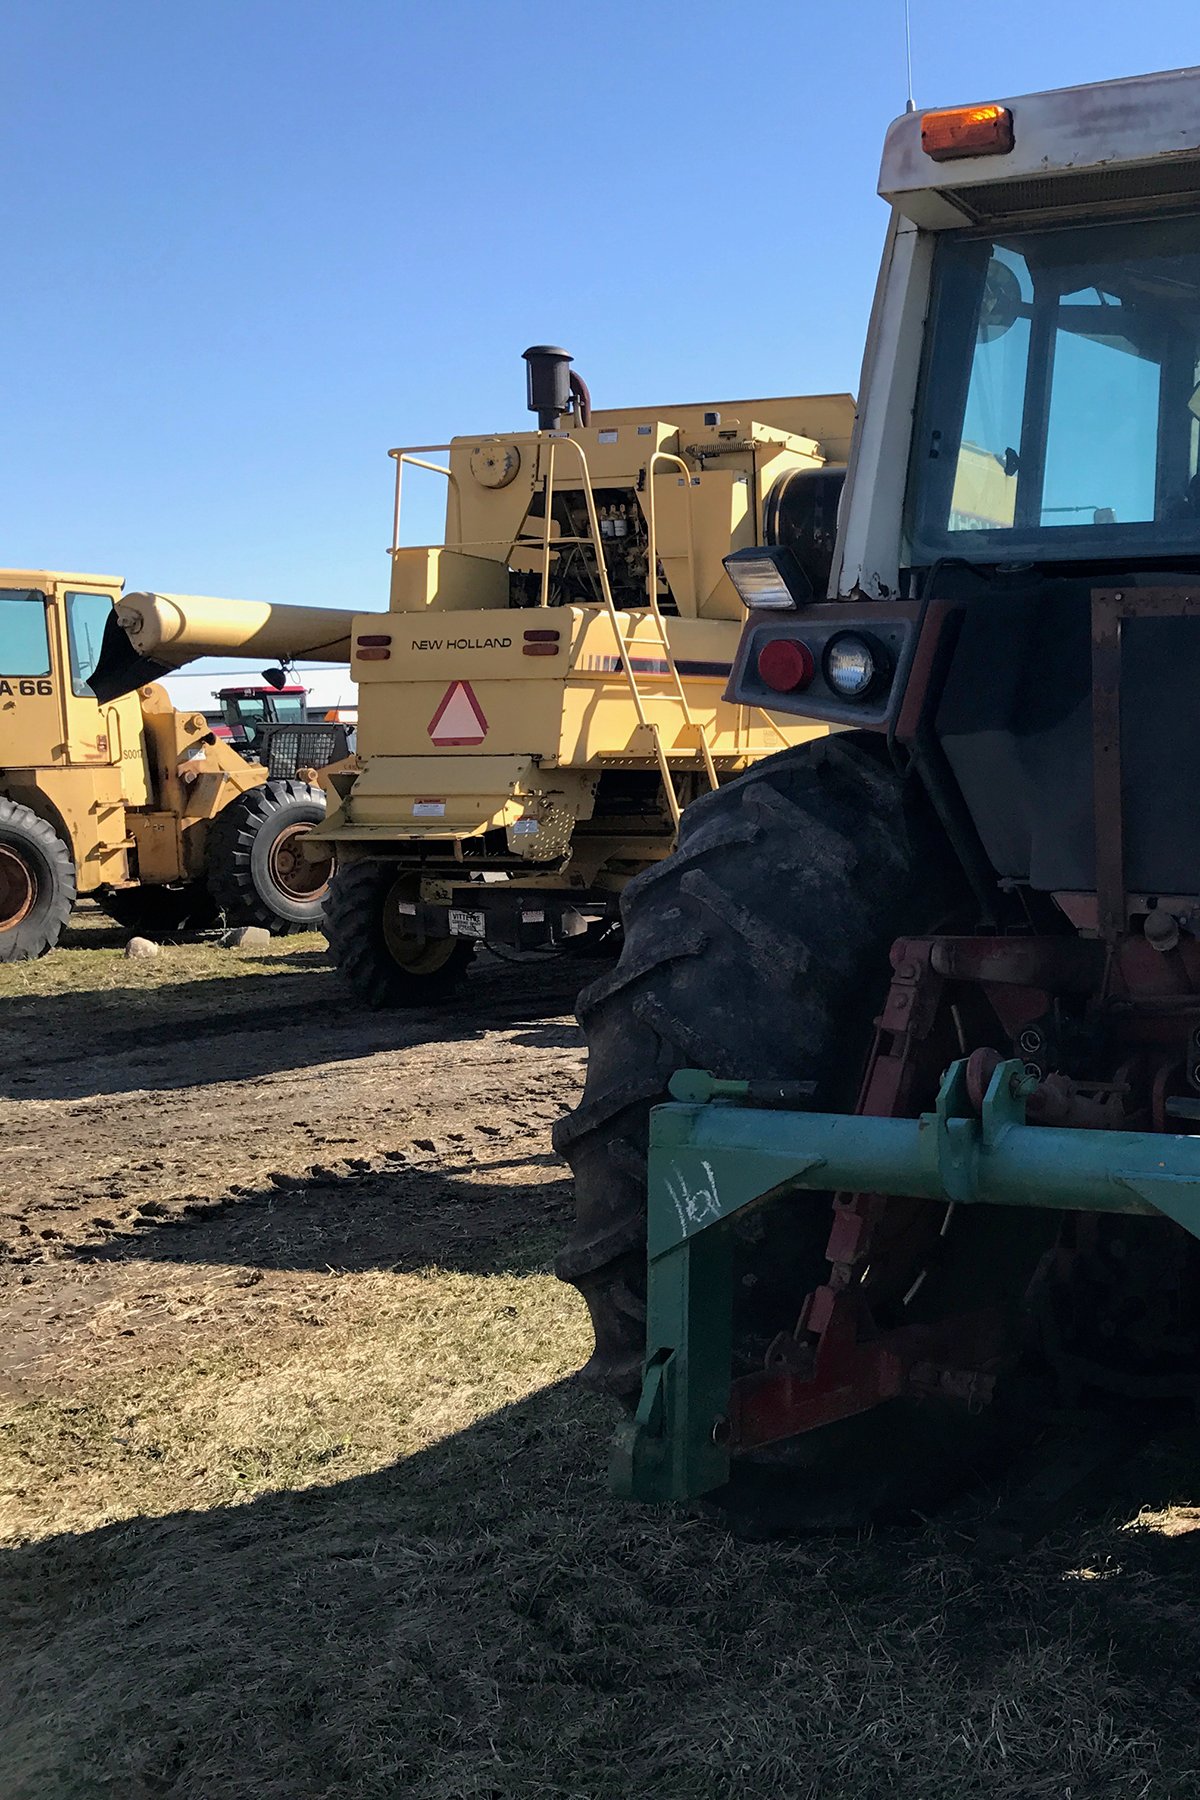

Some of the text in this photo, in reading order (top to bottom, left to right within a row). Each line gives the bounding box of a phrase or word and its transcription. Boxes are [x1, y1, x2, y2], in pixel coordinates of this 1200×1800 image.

[411, 638, 512, 650] NEW HOLLAND
[0, 680, 53, 696] A-66
